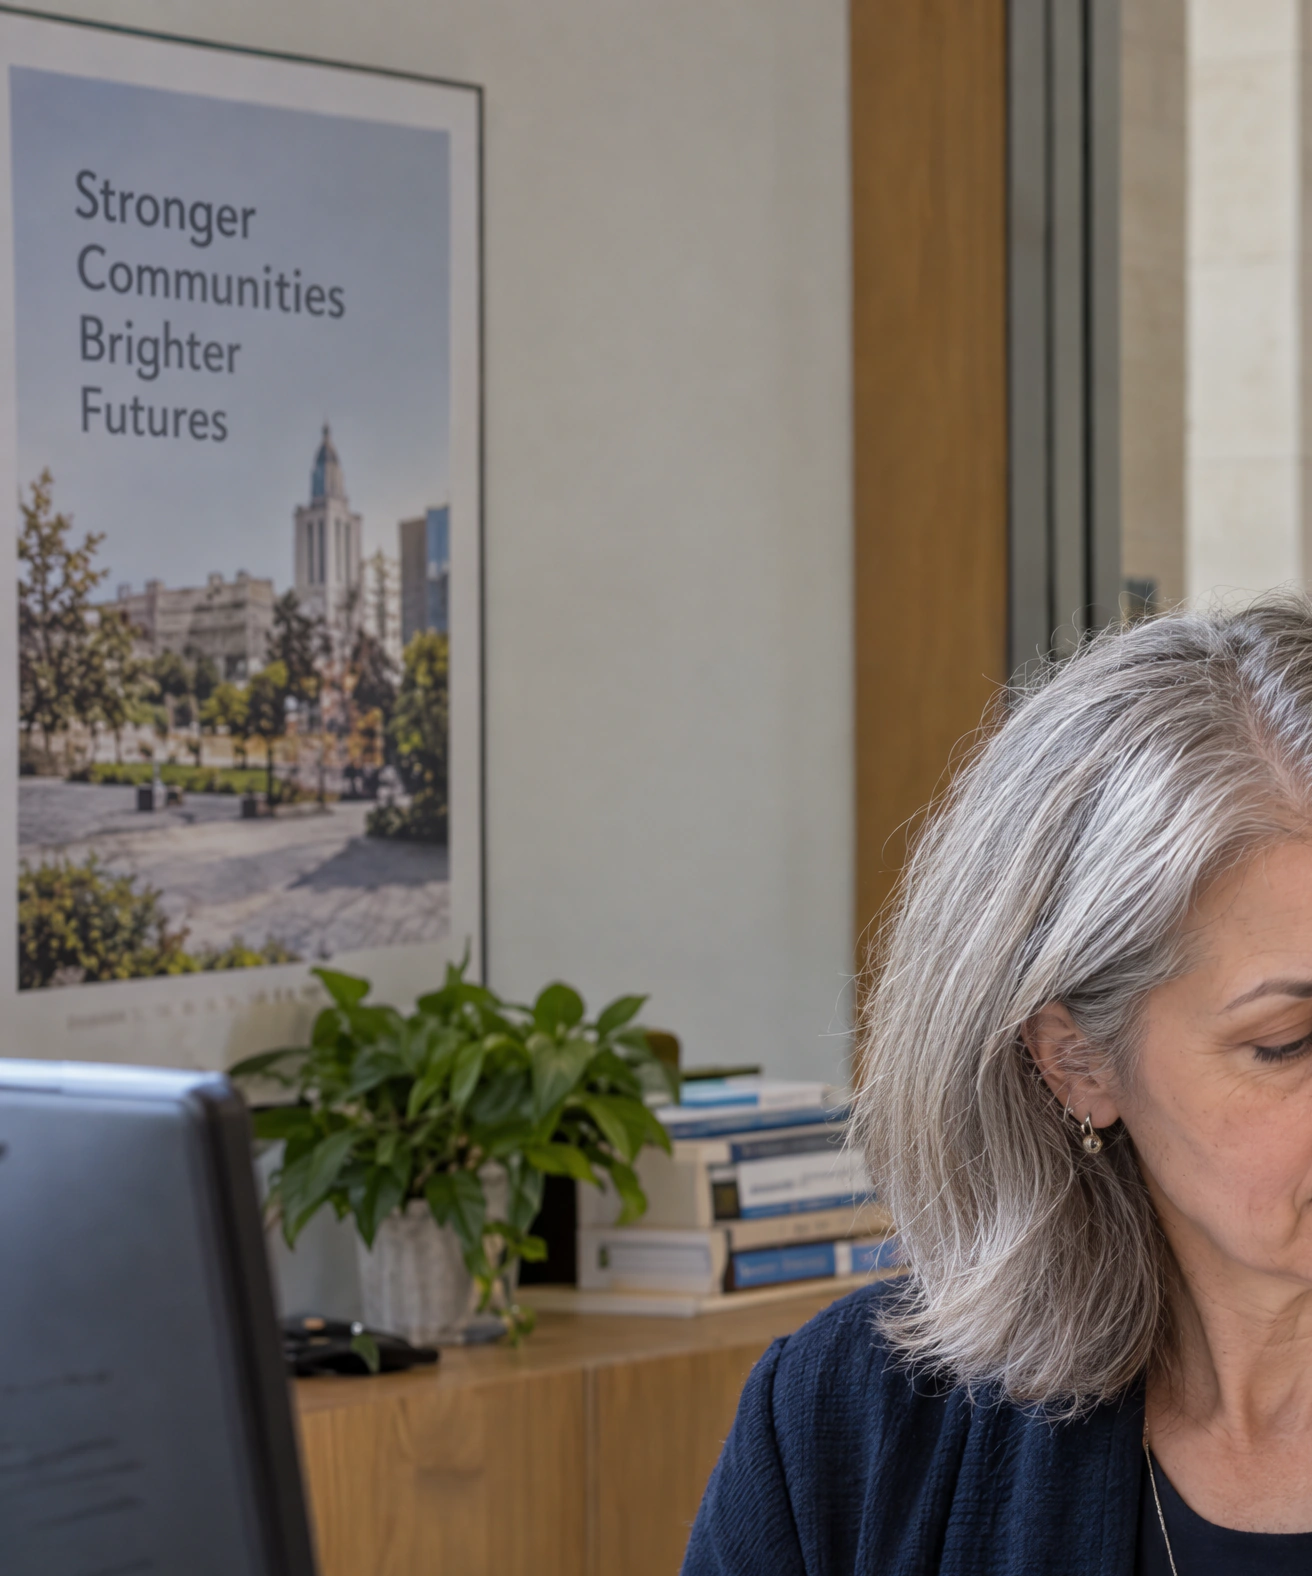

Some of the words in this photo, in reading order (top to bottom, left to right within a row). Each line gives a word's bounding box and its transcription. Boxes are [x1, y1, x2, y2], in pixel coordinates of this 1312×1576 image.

[75, 169, 257, 249] Stronger
[77, 244, 346, 319] Communities
[80, 314, 242, 381] Brighter
[81, 386, 229, 442] Futures
